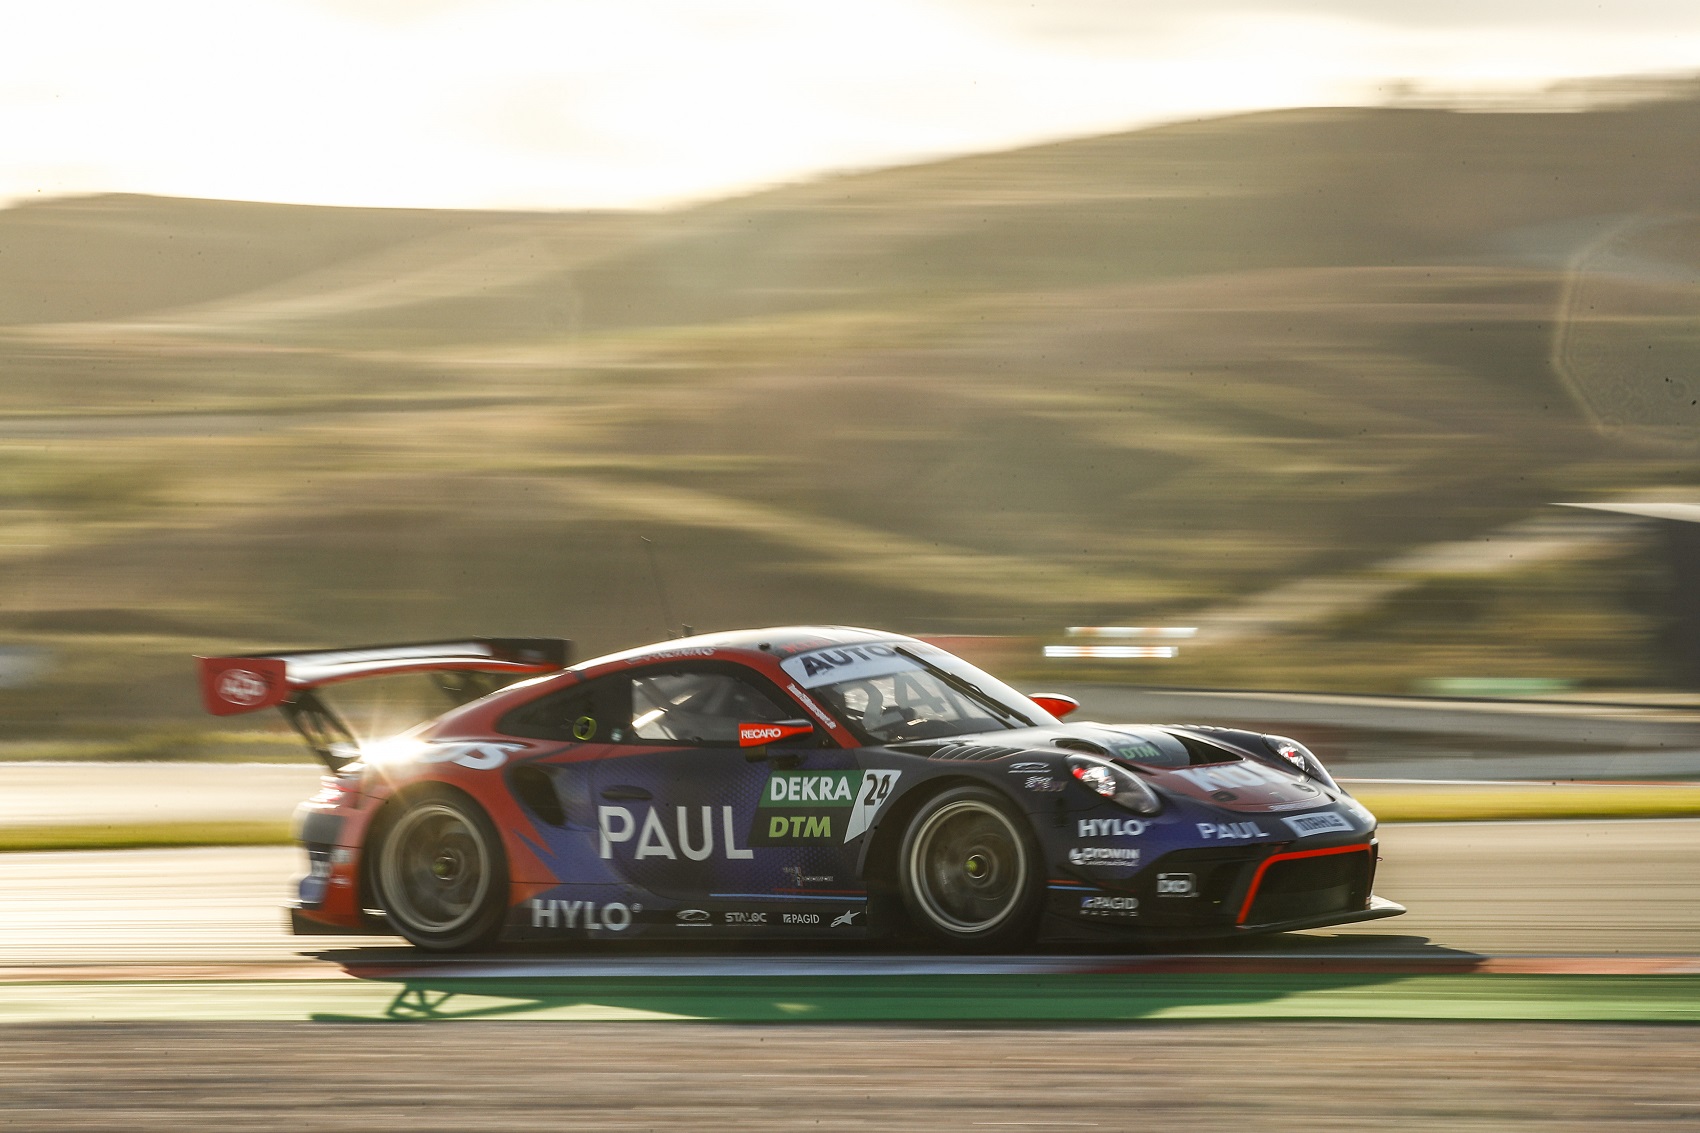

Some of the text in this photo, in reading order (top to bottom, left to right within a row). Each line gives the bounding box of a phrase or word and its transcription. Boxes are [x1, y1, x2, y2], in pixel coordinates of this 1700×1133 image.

[741, 727, 781, 739] RECARO
[1119, 746, 1160, 760] DTM
[770, 776, 853, 801] DEKRA
[863, 773, 892, 806] 24
[598, 805, 754, 861] PAUL
[768, 816, 832, 838] DTM
[1078, 818, 1145, 838] HYLO
[1196, 822, 1271, 840] PAUL
[1093, 896, 1139, 910] PAGID
[531, 899, 633, 931] HYLO
[792, 914, 820, 924] PAGID
